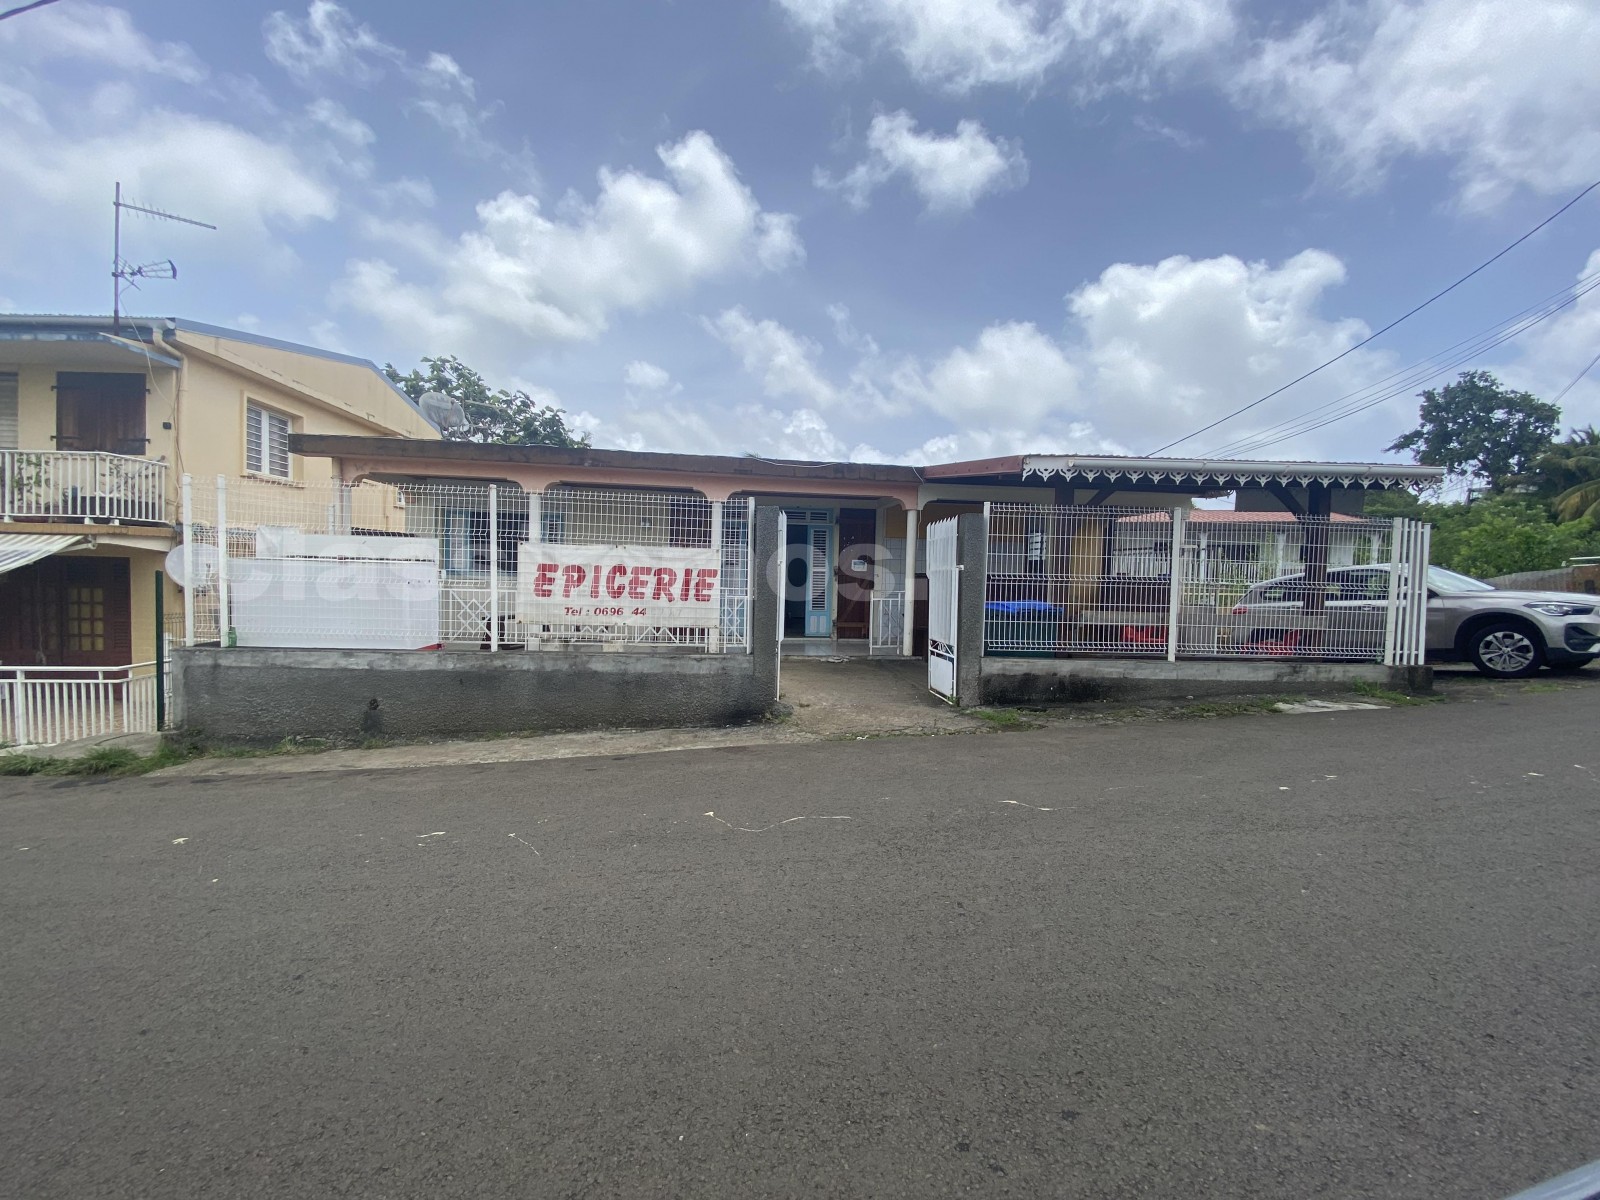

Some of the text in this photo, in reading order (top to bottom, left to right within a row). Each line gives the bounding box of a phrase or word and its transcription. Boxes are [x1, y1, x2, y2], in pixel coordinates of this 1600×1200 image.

[533, 563, 719, 603] EPICERIE
[564, 606, 582, 617] Tel
[592, 606, 625, 617] 0696
